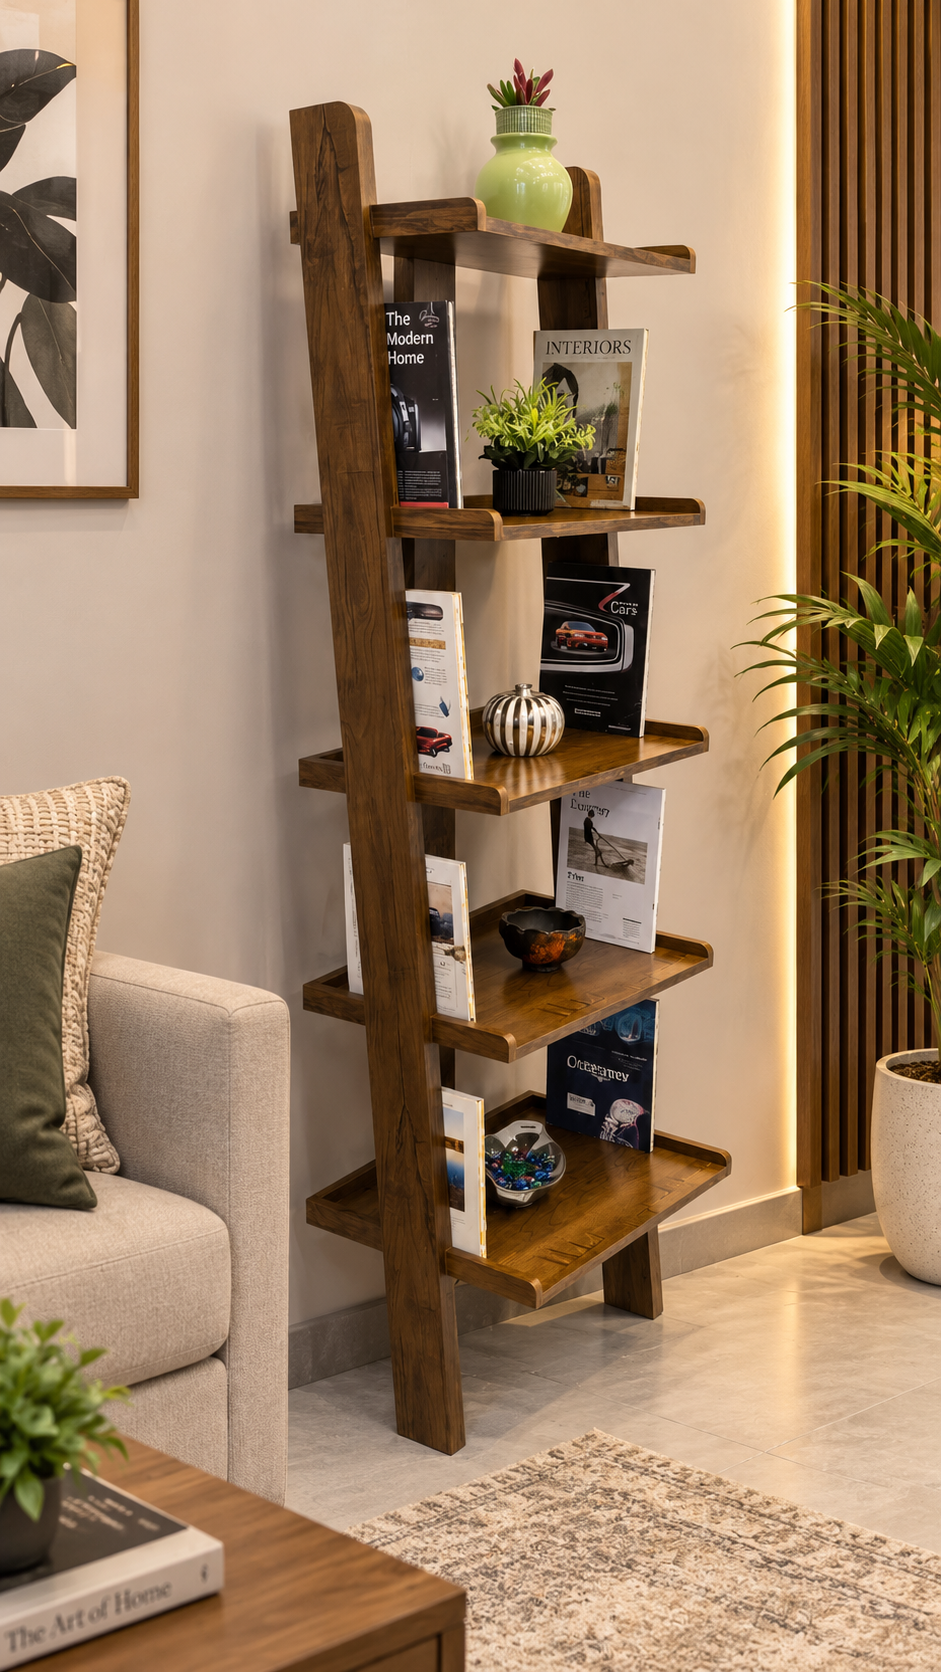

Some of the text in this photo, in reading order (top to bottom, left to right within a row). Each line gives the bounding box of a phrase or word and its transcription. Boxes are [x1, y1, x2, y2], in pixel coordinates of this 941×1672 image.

[385, 311, 411, 326] The
[386, 330, 434, 345] Modern
[545, 339, 632, 355] INTERIORS
[388, 350, 425, 365] Home
[610, 601, 638, 616] Cars
[4, 1581, 173, 1653] The Art of Home
